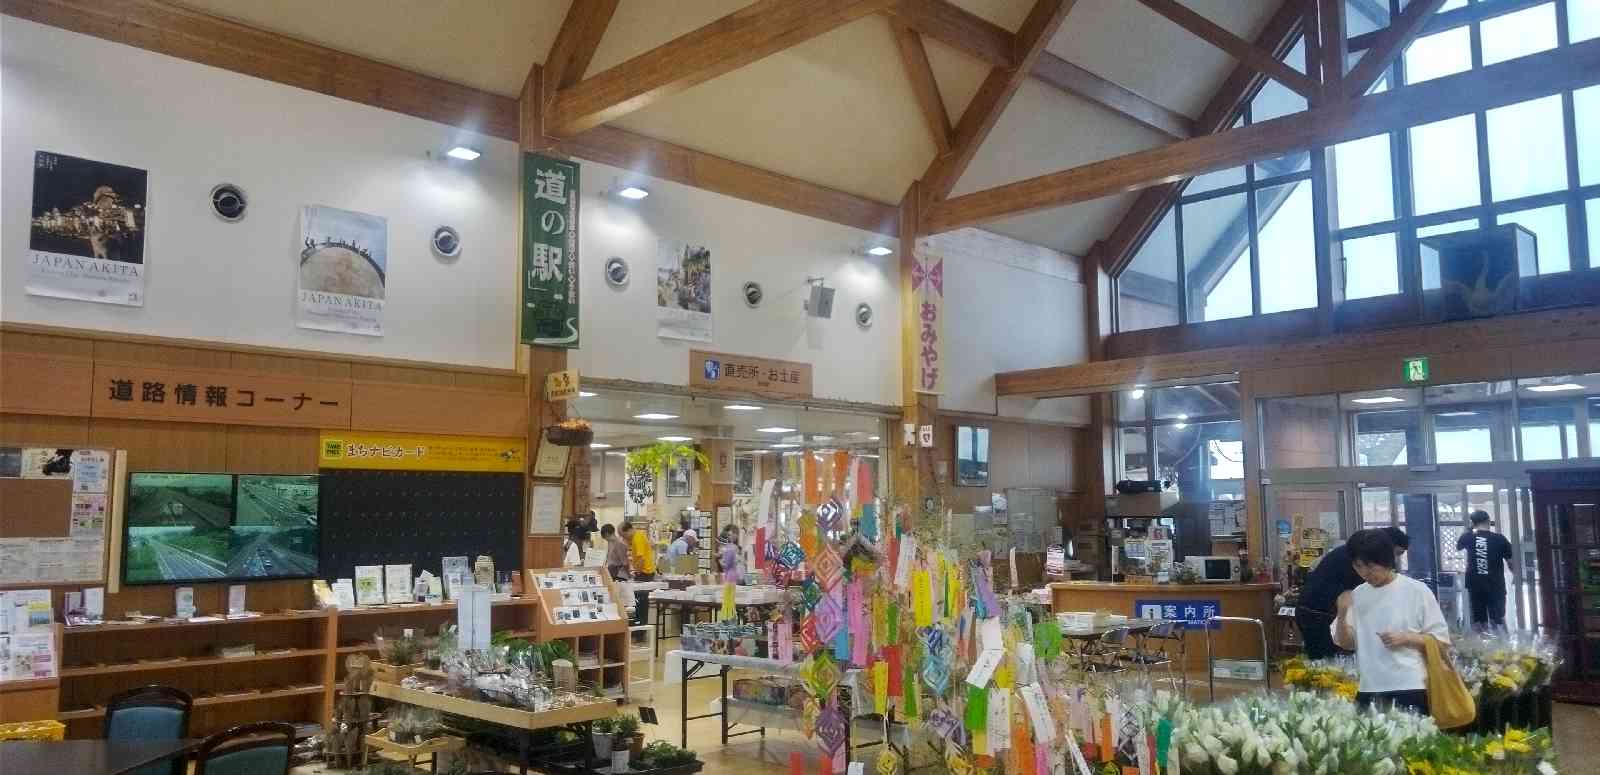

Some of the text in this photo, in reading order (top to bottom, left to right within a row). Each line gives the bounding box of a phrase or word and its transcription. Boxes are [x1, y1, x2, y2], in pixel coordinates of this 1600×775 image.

[32, 254, 85, 270] JAPAN
[89, 261, 139, 277] AKITA
[301, 291, 383, 311] JAPAN AKITA
[919, 303, 938, 390] おみやげ
[108, 378, 339, 411] 道路情報コーナー
[346, 443, 425, 458] まちナビカード
[1475, 536, 1489, 575] NEW ERA
[1163, 604, 1216, 619] 案内所
